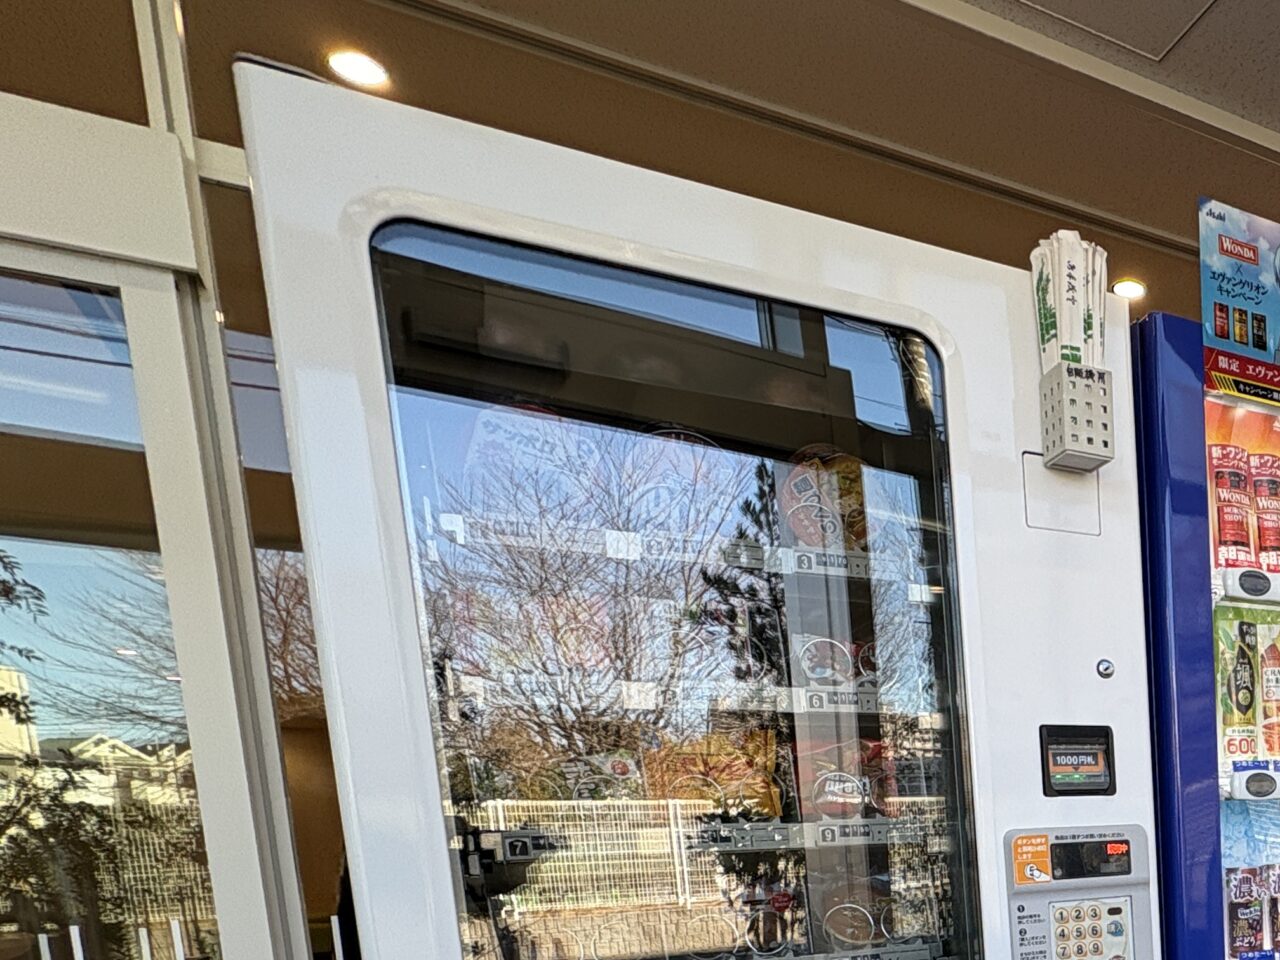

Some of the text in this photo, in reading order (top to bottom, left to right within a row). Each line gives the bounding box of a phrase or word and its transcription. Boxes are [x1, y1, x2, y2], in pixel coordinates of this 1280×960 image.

[1206, 208, 1226, 223] Asahi
[1221, 237, 1255, 260] WONDA
[1209, 271, 1269, 296] エヴァンゲリオン
[1217, 285, 1263, 305] キャンペーン
[1218, 356, 1240, 373] 限定
[801, 558, 808, 568] 3
[812, 694, 821, 707] 6
[1055, 755, 1095, 766] 1000円札
[824, 830, 832, 841] 9
[1233, 875, 1269, 901] 濃い
[1074, 910, 1082, 919] 2
[1090, 909, 1097, 918] 3
[1059, 926, 1098, 938] 4 5 6
[1060, 943, 1099, 956] 7 8 9
